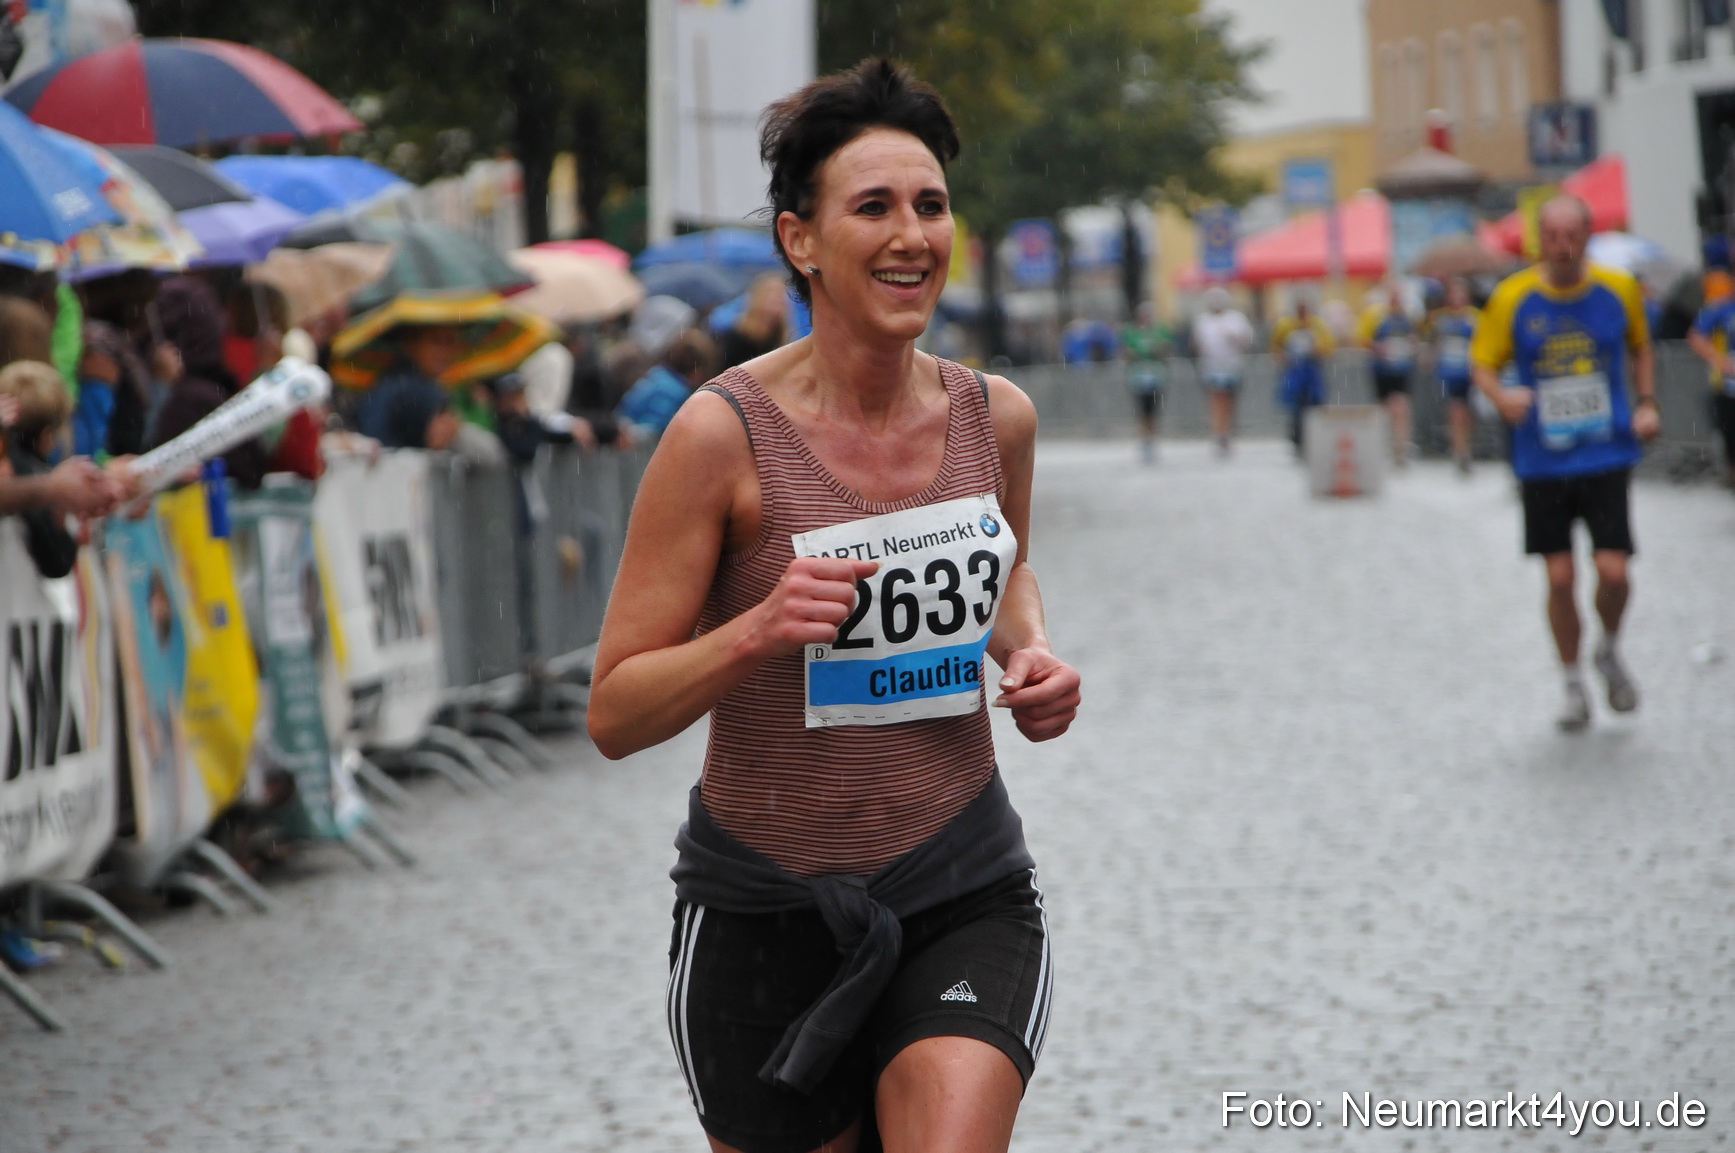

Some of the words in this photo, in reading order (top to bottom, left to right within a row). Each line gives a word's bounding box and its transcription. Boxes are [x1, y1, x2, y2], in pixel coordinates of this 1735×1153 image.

[882, 521, 977, 557] Neumarkt
[831, 549, 1000, 649] 2633
[815, 647, 824, 659] D
[869, 656, 979, 698] Claudia
[940, 992, 977, 1002] adidas
